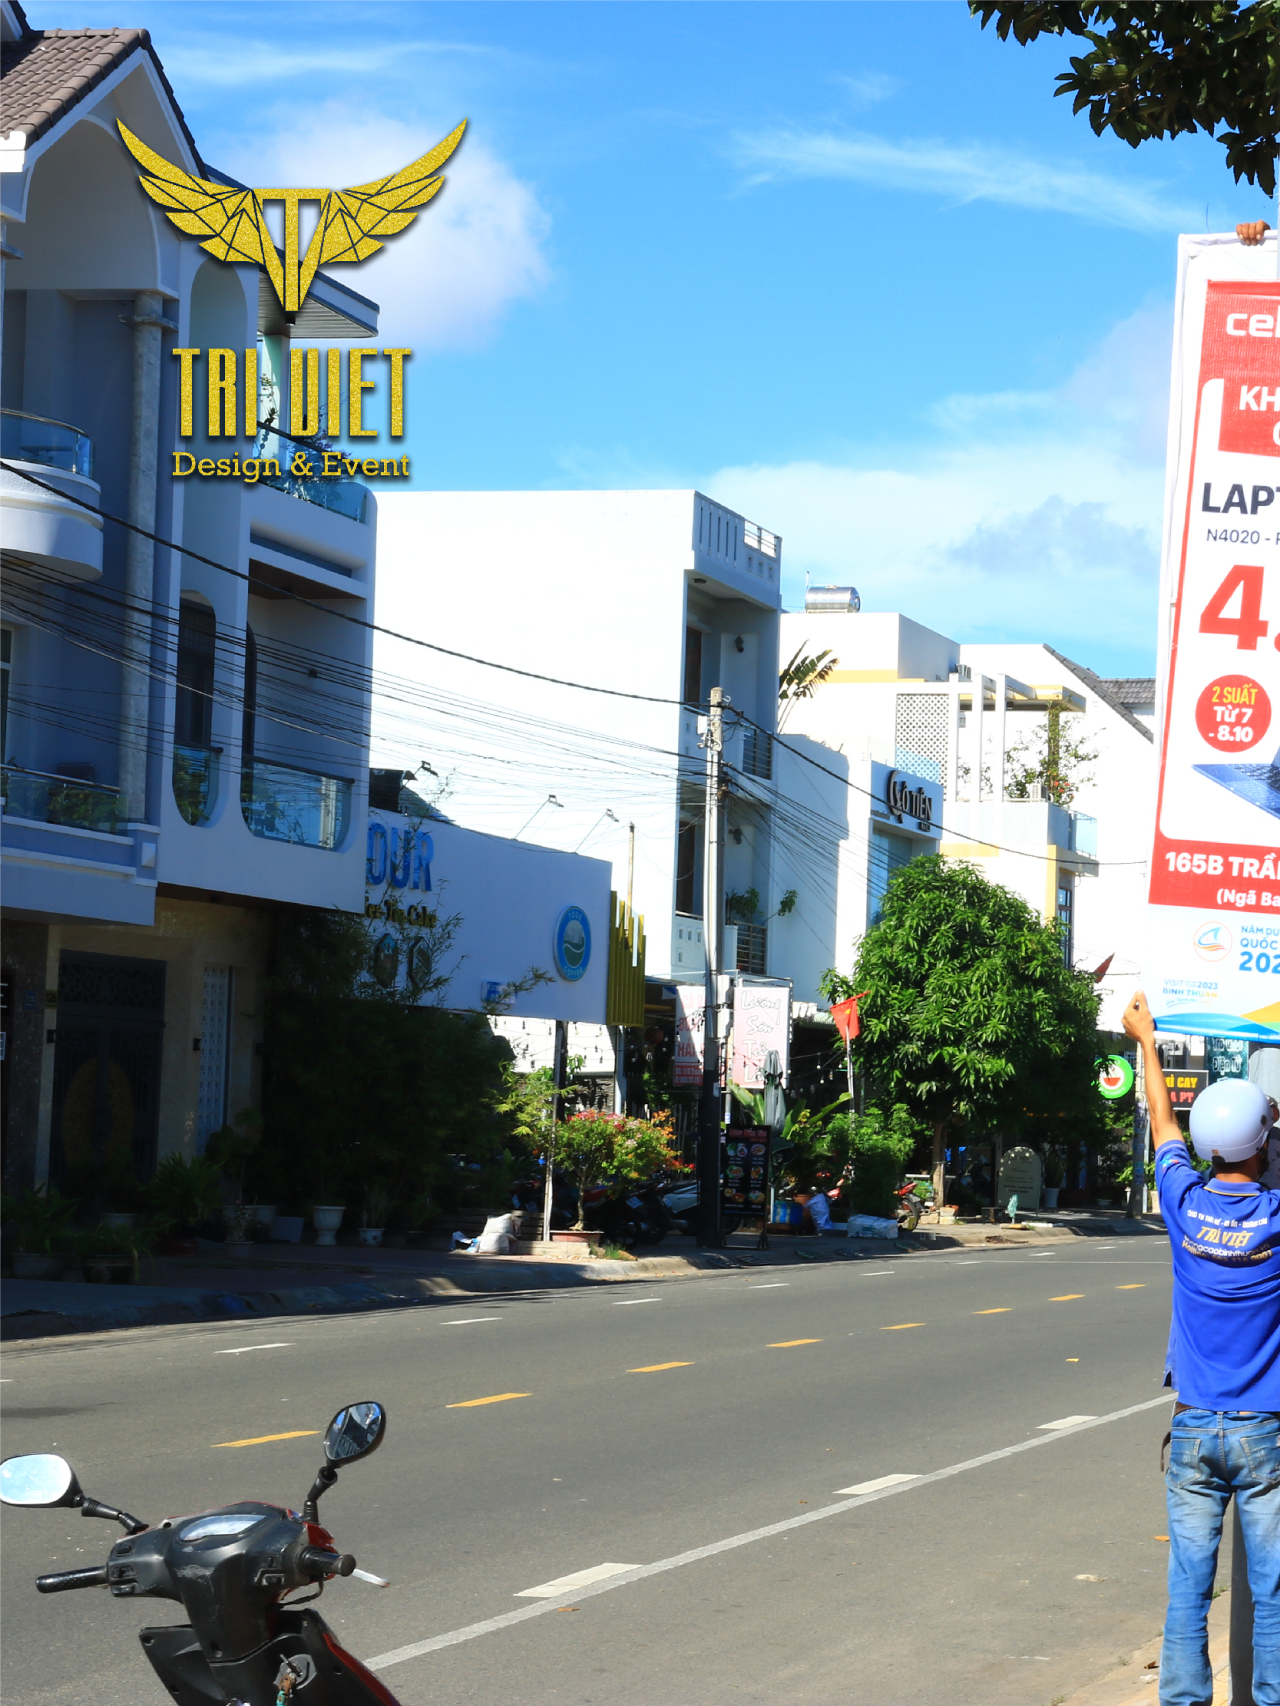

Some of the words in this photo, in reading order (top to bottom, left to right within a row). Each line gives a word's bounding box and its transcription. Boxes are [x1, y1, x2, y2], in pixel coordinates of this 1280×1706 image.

[1206, 527, 1262, 546] N4020
[1211, 686, 1222, 703] 2
[1222, 683, 1259, 706] SUẤT
[1214, 705, 1238, 723] Từ
[1241, 708, 1252, 724] 7
[1217, 726, 1254, 743] 8.10
[1165, 851, 1225, 877] 165B
[1216, 888, 1257, 909] (Ngã
[1241, 924, 1266, 936] NĂM
[1266, 927, 1280, 938] DU
[1240, 936, 1279, 952] QUỐC
[1197, 981, 1218, 991] 2023
[1176, 1076, 1198, 1089] CAY
